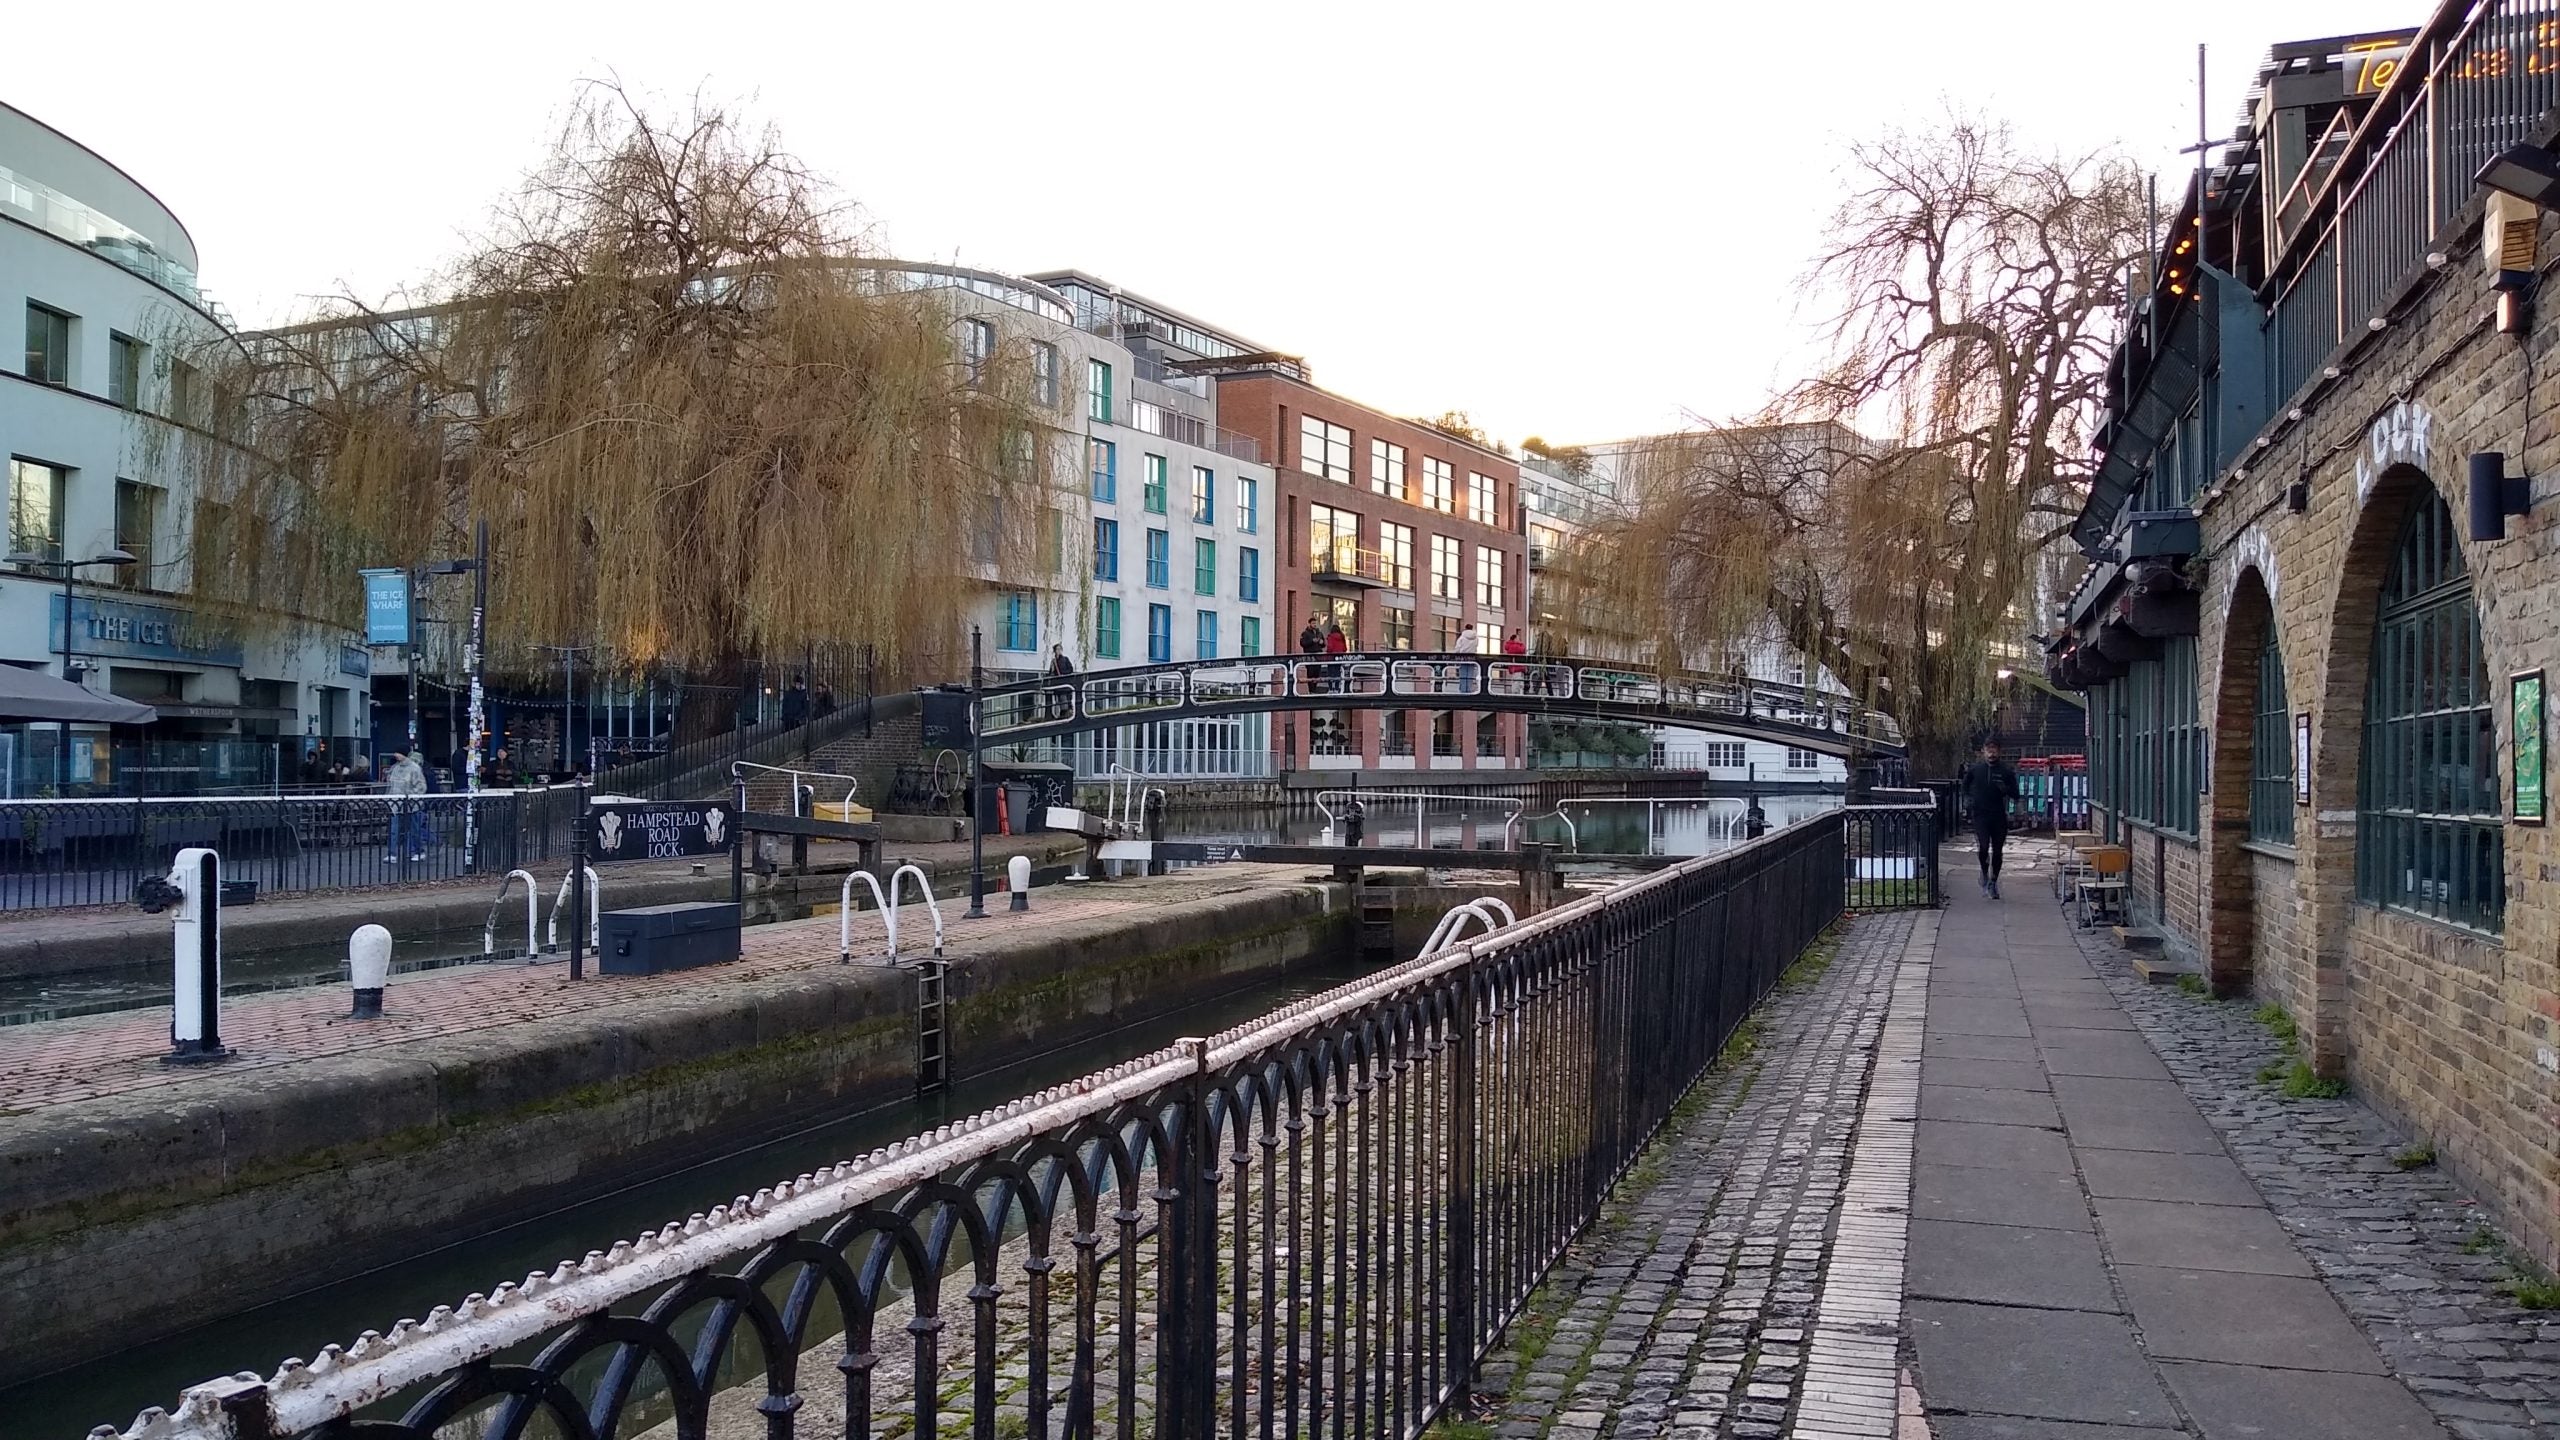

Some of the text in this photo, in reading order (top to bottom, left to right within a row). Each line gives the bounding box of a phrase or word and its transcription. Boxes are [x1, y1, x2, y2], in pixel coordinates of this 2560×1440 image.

[2356, 402, 2432, 500] LOCK
[371, 590, 404, 600] THE ICE
[371, 600, 404, 609] WHARF
[89, 615, 130, 641] THE
[134, 620, 164, 644] ICE
[189, 707, 233, 716] WETHERSPOON
[627, 811, 700, 829] HAMPSTEAD
[648, 827, 680, 843] ROAD
[648, 842, 679, 858] LOCK
